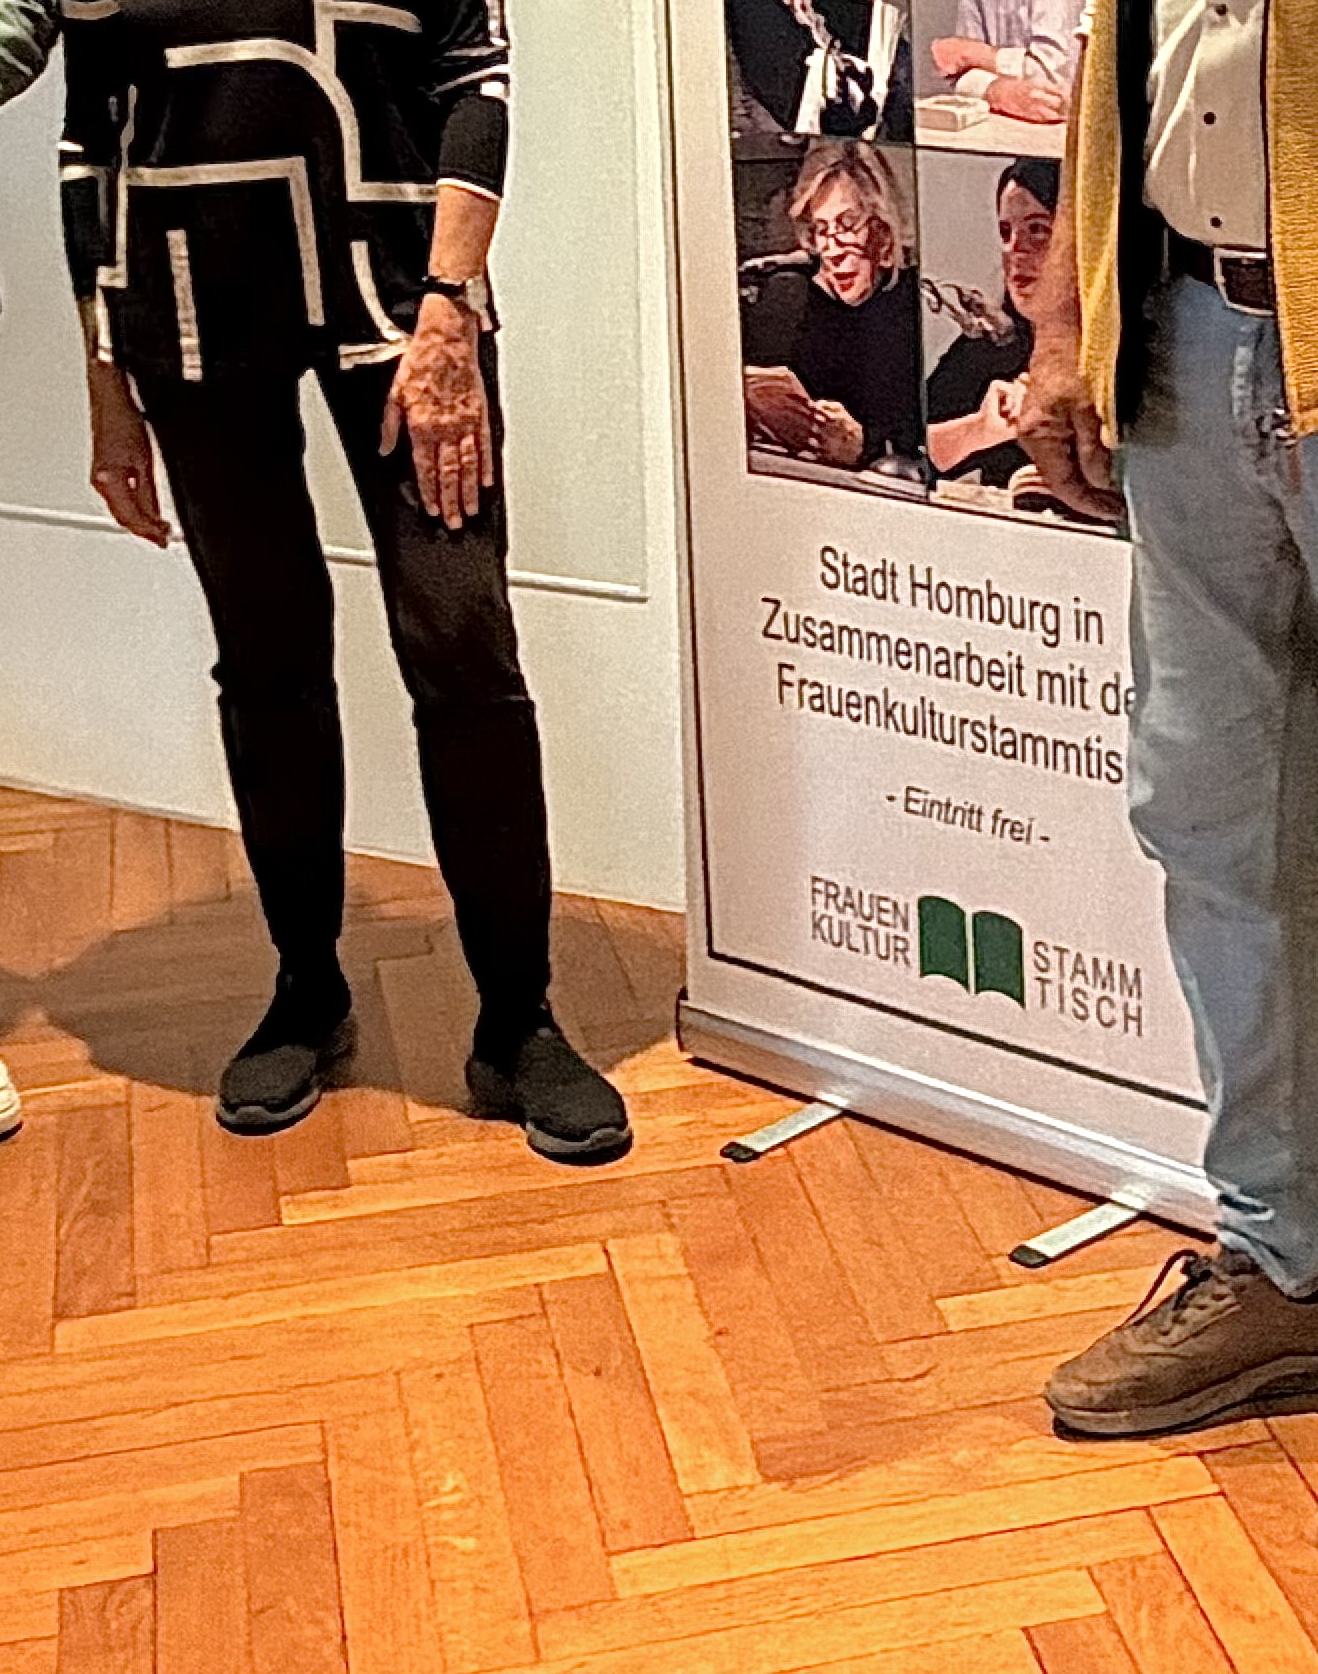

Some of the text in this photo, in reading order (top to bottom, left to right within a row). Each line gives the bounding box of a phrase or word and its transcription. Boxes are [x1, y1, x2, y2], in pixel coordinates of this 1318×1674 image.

[820, 546, 1103, 646] Stadt Homburg in
[761, 598, 1026, 697] Zusammenarbeit
[1038, 663, 1087, 710] mit
[778, 664, 1123, 784] Frauenkulturstammtis
[904, 786, 983, 833] Eintritt
[991, 809, 1035, 845] frei
[811, 876, 910, 931] FRAUEN
[811, 910, 910, 967] KULTUR
[1033, 941, 1142, 1000] STAMM
[1033, 978, 1143, 1037] TISCH
